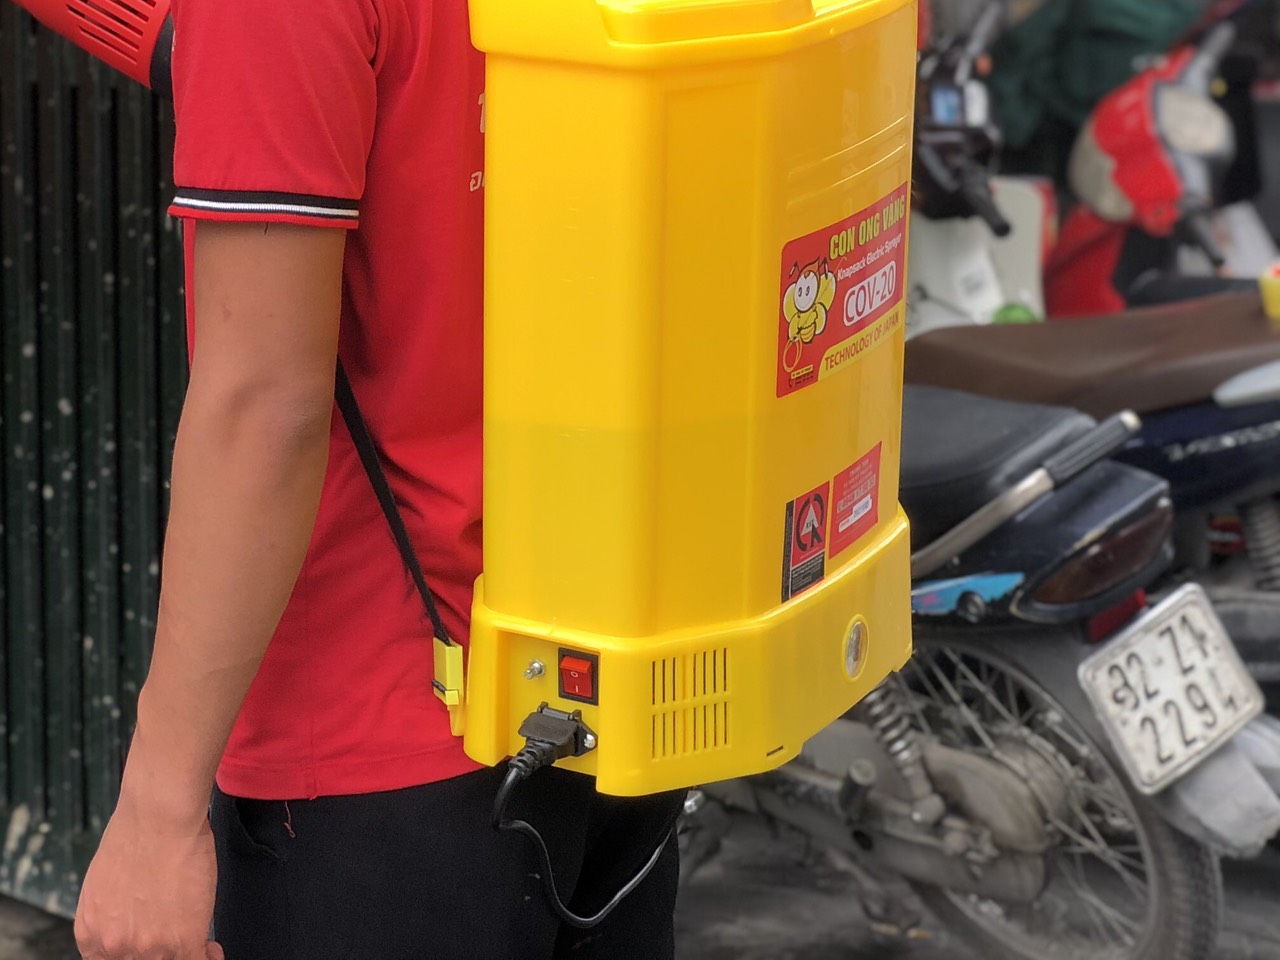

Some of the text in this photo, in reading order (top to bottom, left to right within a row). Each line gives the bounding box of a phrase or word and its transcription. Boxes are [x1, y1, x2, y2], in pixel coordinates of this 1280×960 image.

[829, 194, 906, 260] CON ONG VÀNG
[837, 256, 867, 281] Knapsack
[845, 264, 895, 323] COV-20
[824, 310, 900, 371] TECHNOLOGY OF JAPAN
